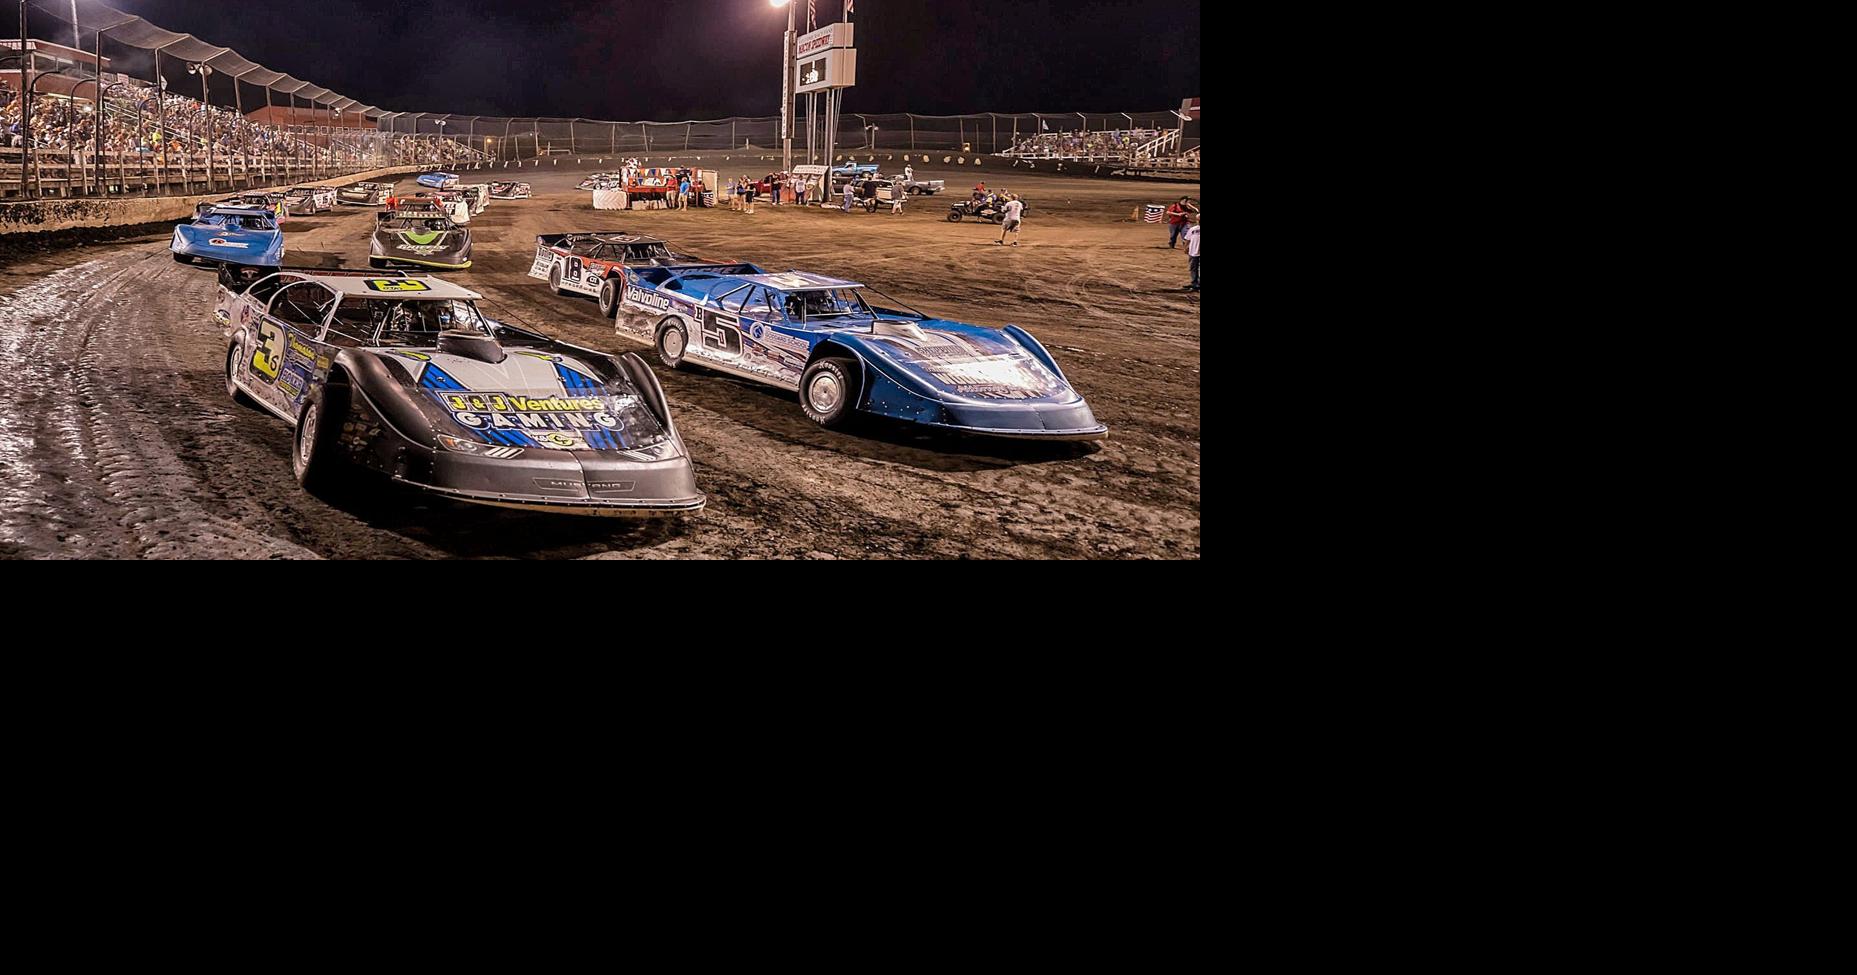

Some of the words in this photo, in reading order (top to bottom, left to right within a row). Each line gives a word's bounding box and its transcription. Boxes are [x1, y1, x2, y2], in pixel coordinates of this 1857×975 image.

[564, 256, 582, 283] 18
[627, 285, 669, 311] Valvoline
[702, 308, 743, 357] 5
[451, 397, 466, 411] J
[471, 398, 483, 409] &
[490, 397, 506, 411] J
[508, 396, 605, 413] Ventures
[455, 411, 617, 429] GAMING
